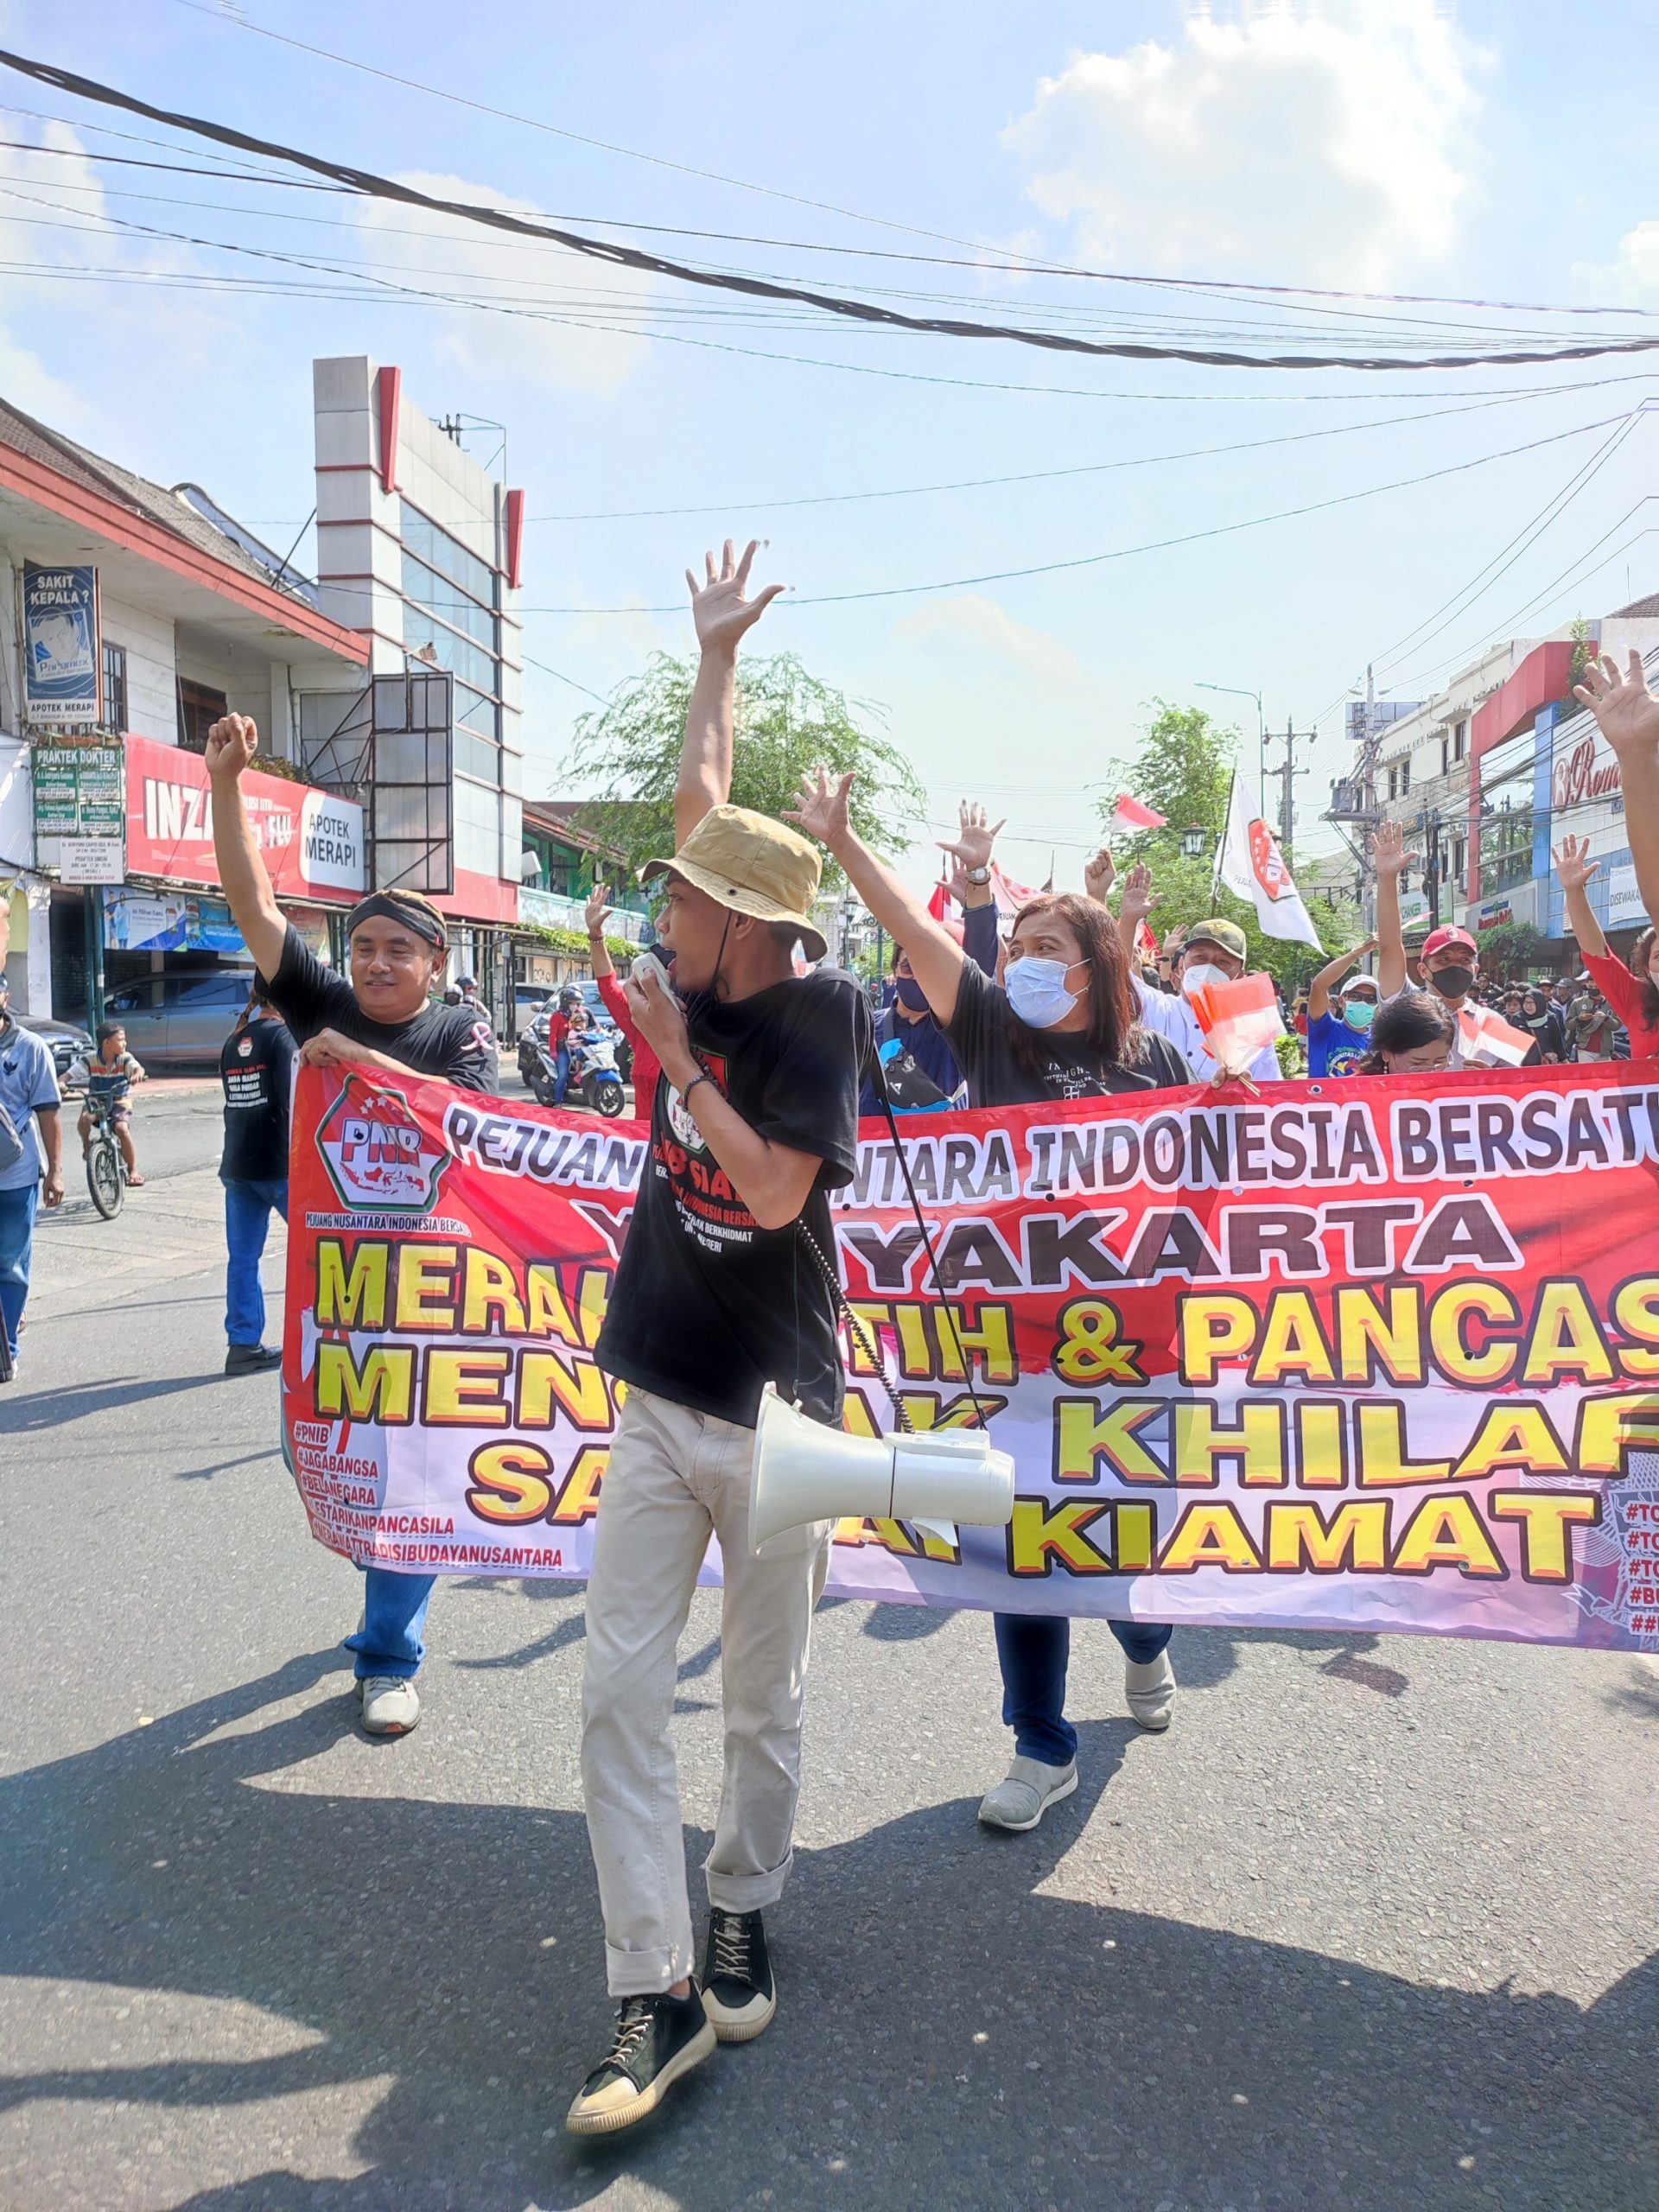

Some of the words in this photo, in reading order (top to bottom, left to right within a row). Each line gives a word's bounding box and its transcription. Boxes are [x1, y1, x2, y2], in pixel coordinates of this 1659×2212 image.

[37, 575, 74, 589] SAKIT
[30, 592, 79, 605] KEPALA
[31, 702, 61, 712] APOTEK
[65, 702, 94, 712] MERAPI
[37, 750, 77, 764] PRAKTEK
[79, 750, 116, 764] DOKTER
[309, 813, 350, 840] APOTEK
[305, 836, 357, 868] MERAPI
[1610, 887, 1641, 906] DISEWAKA
[448, 1107, 645, 1187] PEJUAN
[1031, 1109, 1381, 1192] INDONESIA
[307, 1212, 332, 1227] PEJUANG
[334, 1214, 387, 1230] NUSANTARA
[389, 1216, 438, 1231] INDONESIA
[704, 1221, 753, 1243] BERKHIDMAT
[1057, 1295, 1148, 1388] &
[296, 1422, 328, 1443] #PNIB
[298, 1446, 378, 1478] #JAGABANGSA
[302, 1474, 376, 1505] #BELANEGARA
[1007, 1491, 1600, 1583] KIAMAT
